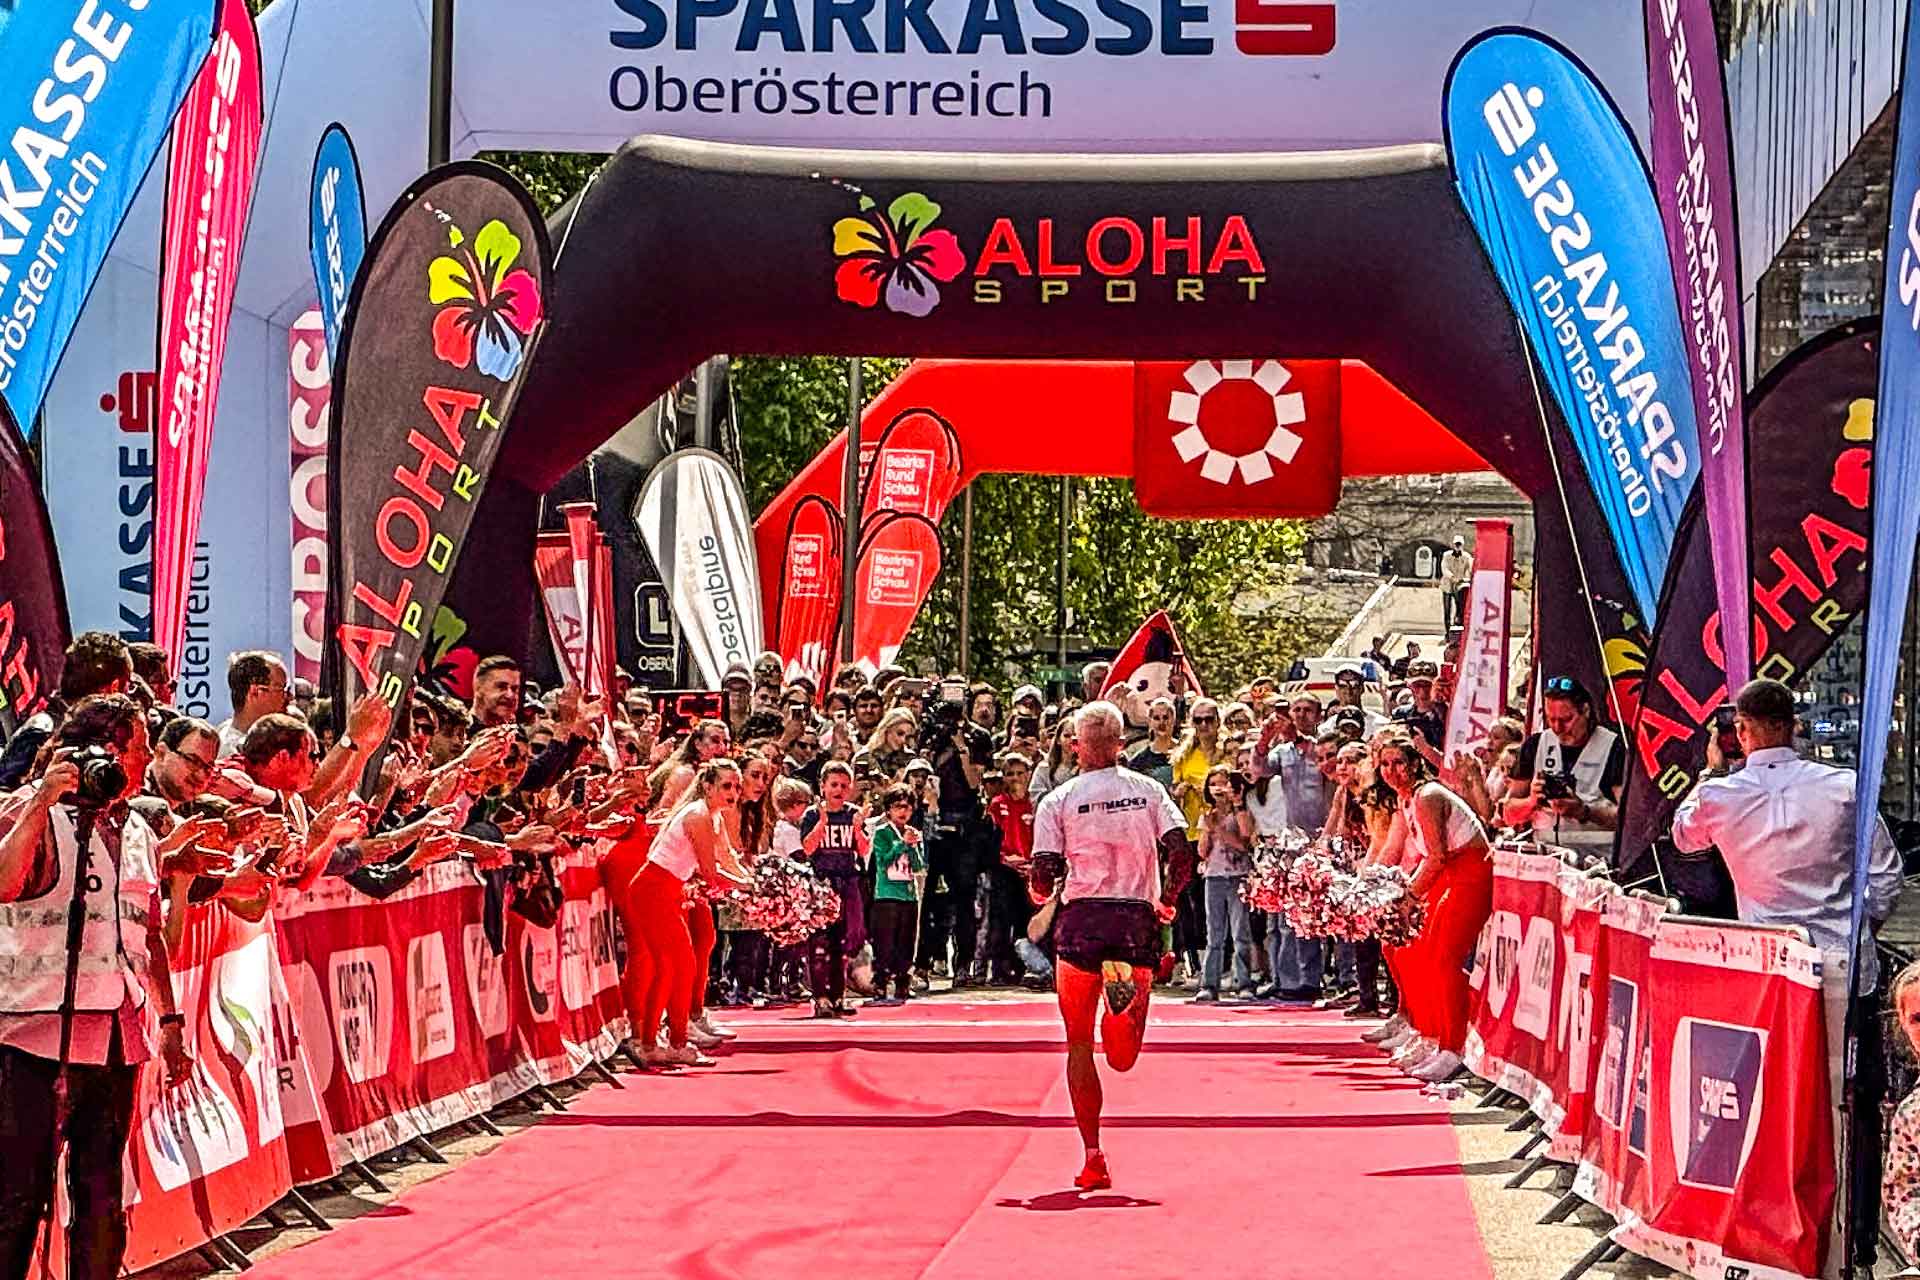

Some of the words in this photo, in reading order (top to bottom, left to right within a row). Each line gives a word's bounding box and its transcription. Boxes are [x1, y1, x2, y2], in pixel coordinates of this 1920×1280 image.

[608, 0, 1214, 56] SPARKASSE
[608, 65, 1052, 118] Oberösterreich
[973, 215, 1267, 277] ALOHA
[973, 276, 1268, 304] SPORT
[883, 482, 920, 496] Schau
[884, 469, 916, 483] Rund
[336, 386, 484, 693] ALOHA
[379, 398, 501, 708] SPORT
[820, 824, 855, 849] NEW
